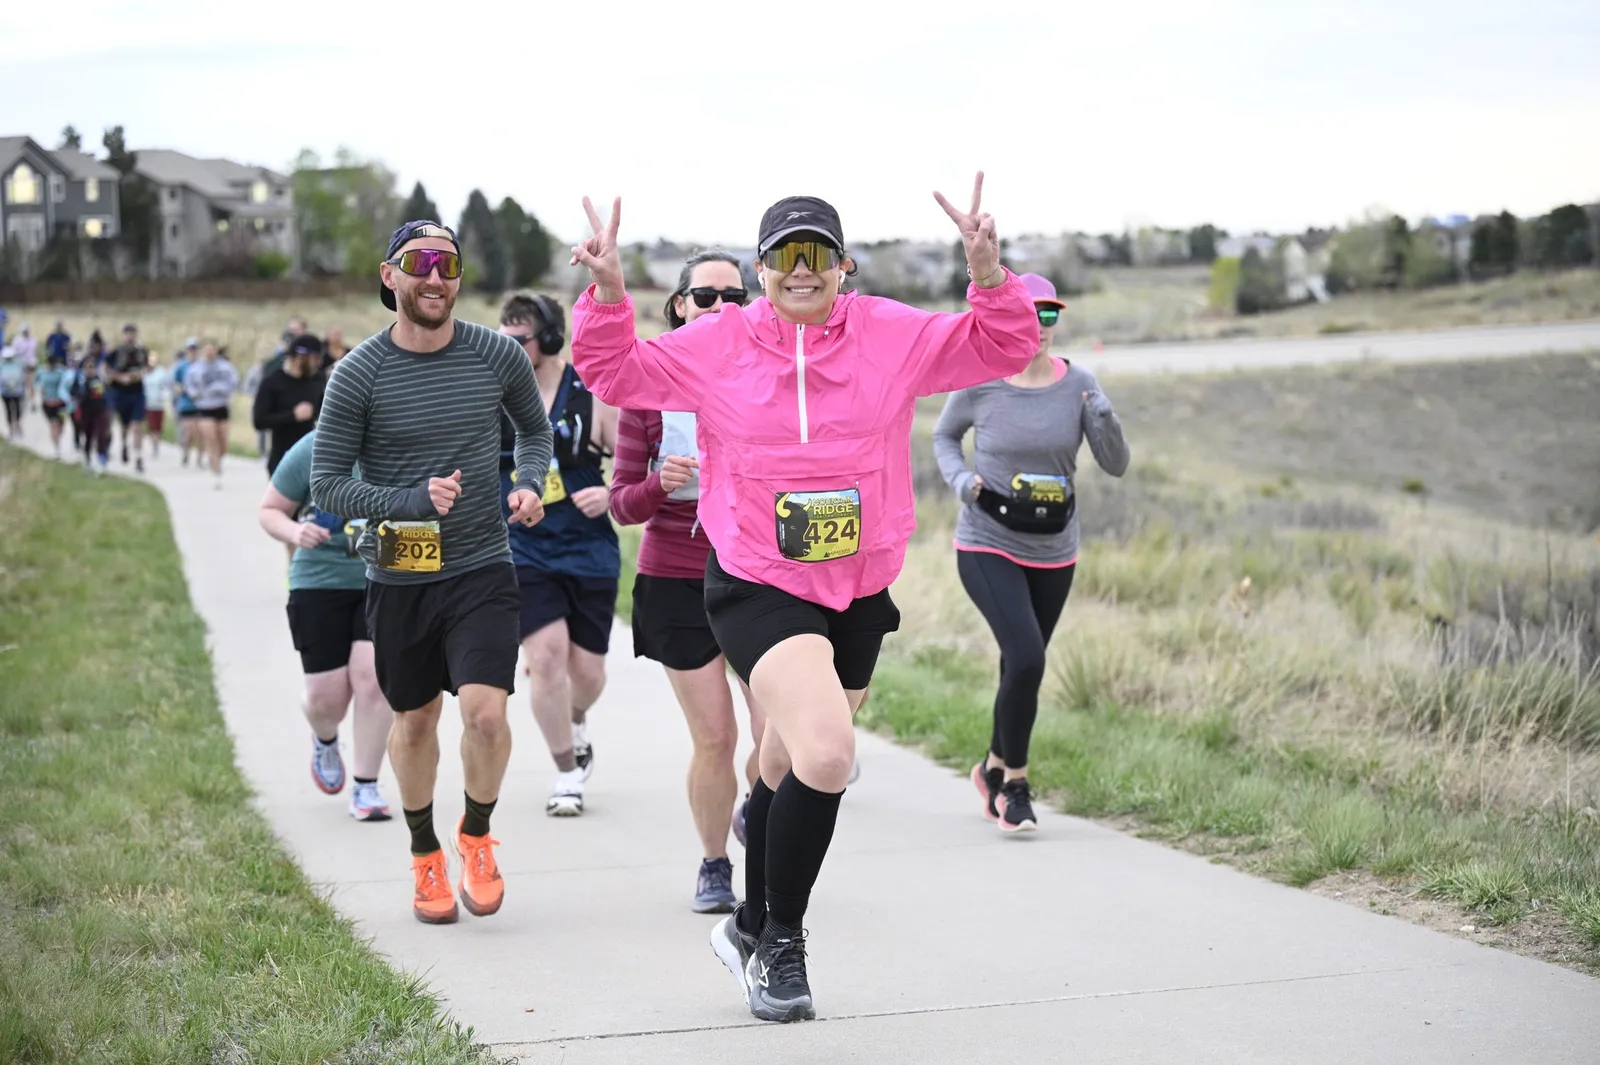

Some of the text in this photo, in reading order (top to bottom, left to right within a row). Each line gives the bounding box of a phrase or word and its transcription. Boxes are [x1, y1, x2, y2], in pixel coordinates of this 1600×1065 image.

[813, 503, 854, 515] RIDGE
[402, 531, 435, 539] RIDGE
[804, 519, 857, 545] 424
[395, 542, 438, 560] 202
